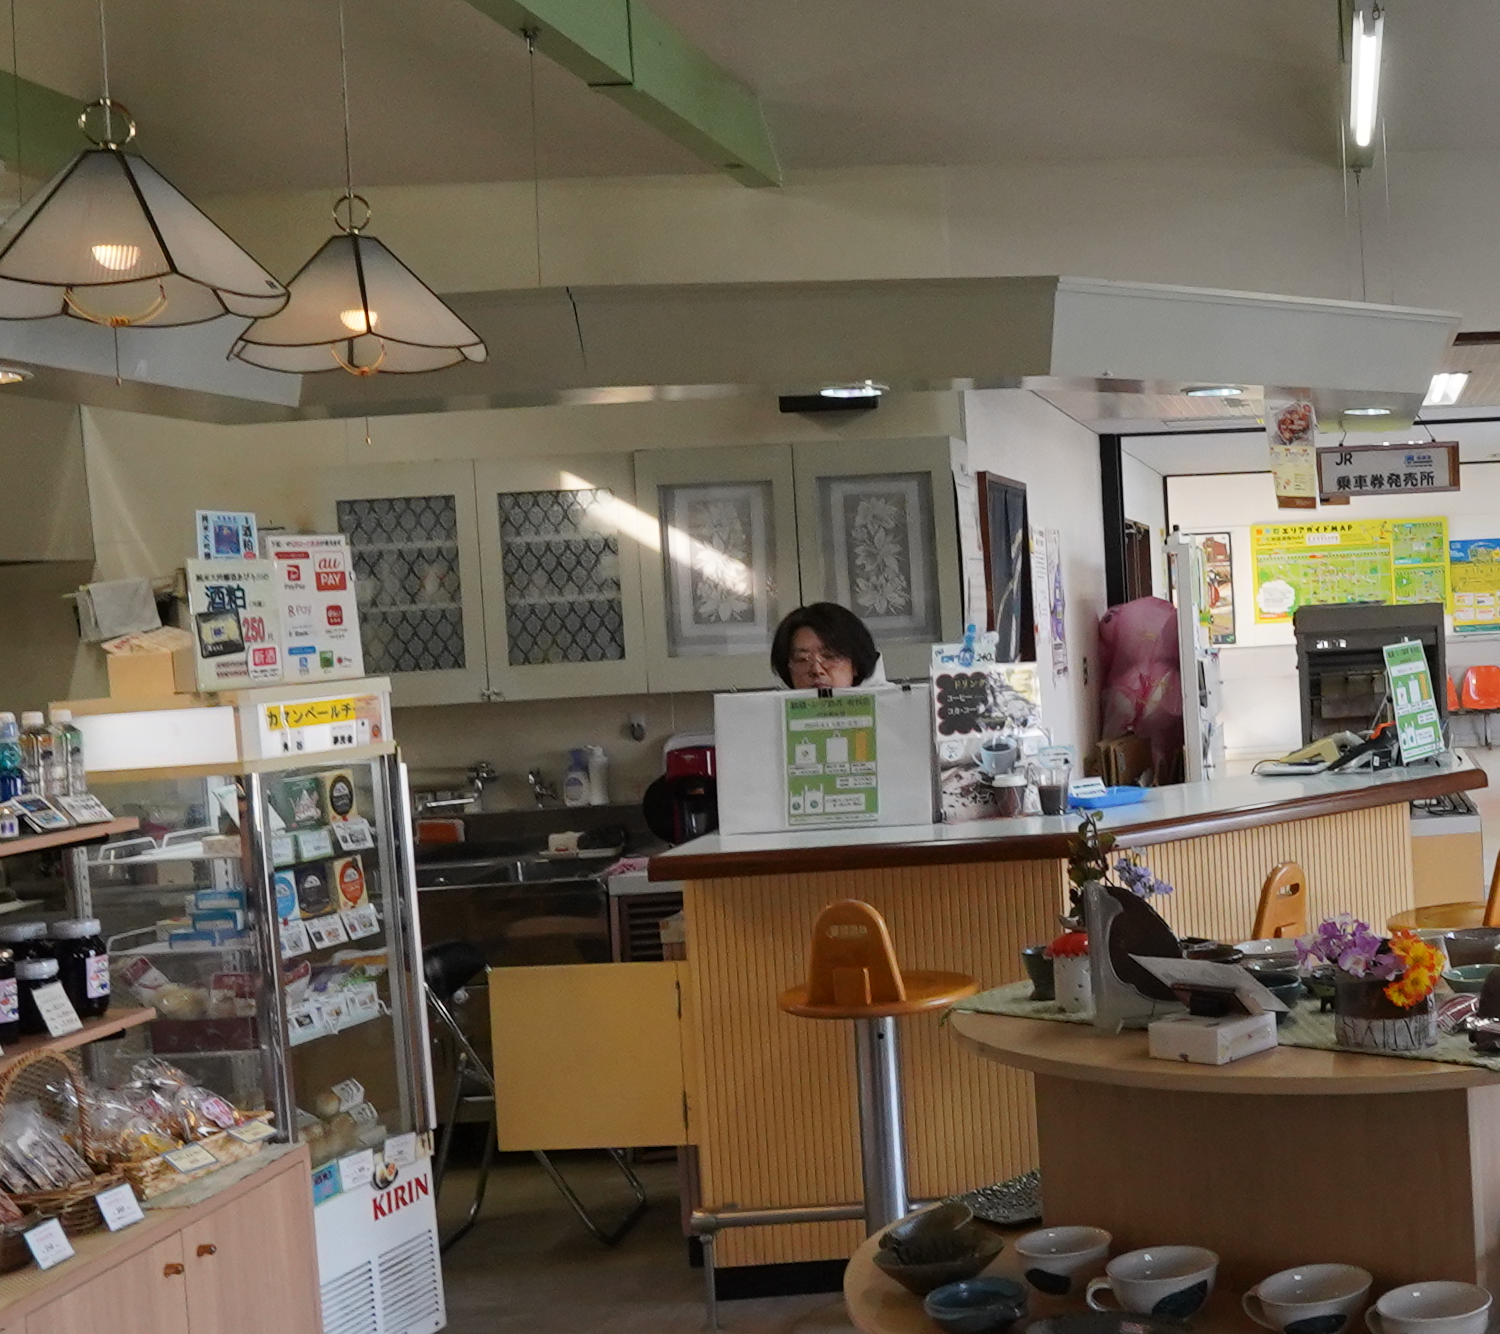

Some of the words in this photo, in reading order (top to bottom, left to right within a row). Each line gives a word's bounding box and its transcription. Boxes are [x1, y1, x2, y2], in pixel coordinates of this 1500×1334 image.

[1335, 452, 1353, 466] JR
[1336, 471, 1435, 491] 乗車券発売所
[320, 573, 342, 587] PAY
[205, 584, 247, 612] 酒粕
[243, 617, 266, 643] 250
[372, 1174, 429, 1220] KIRIN
